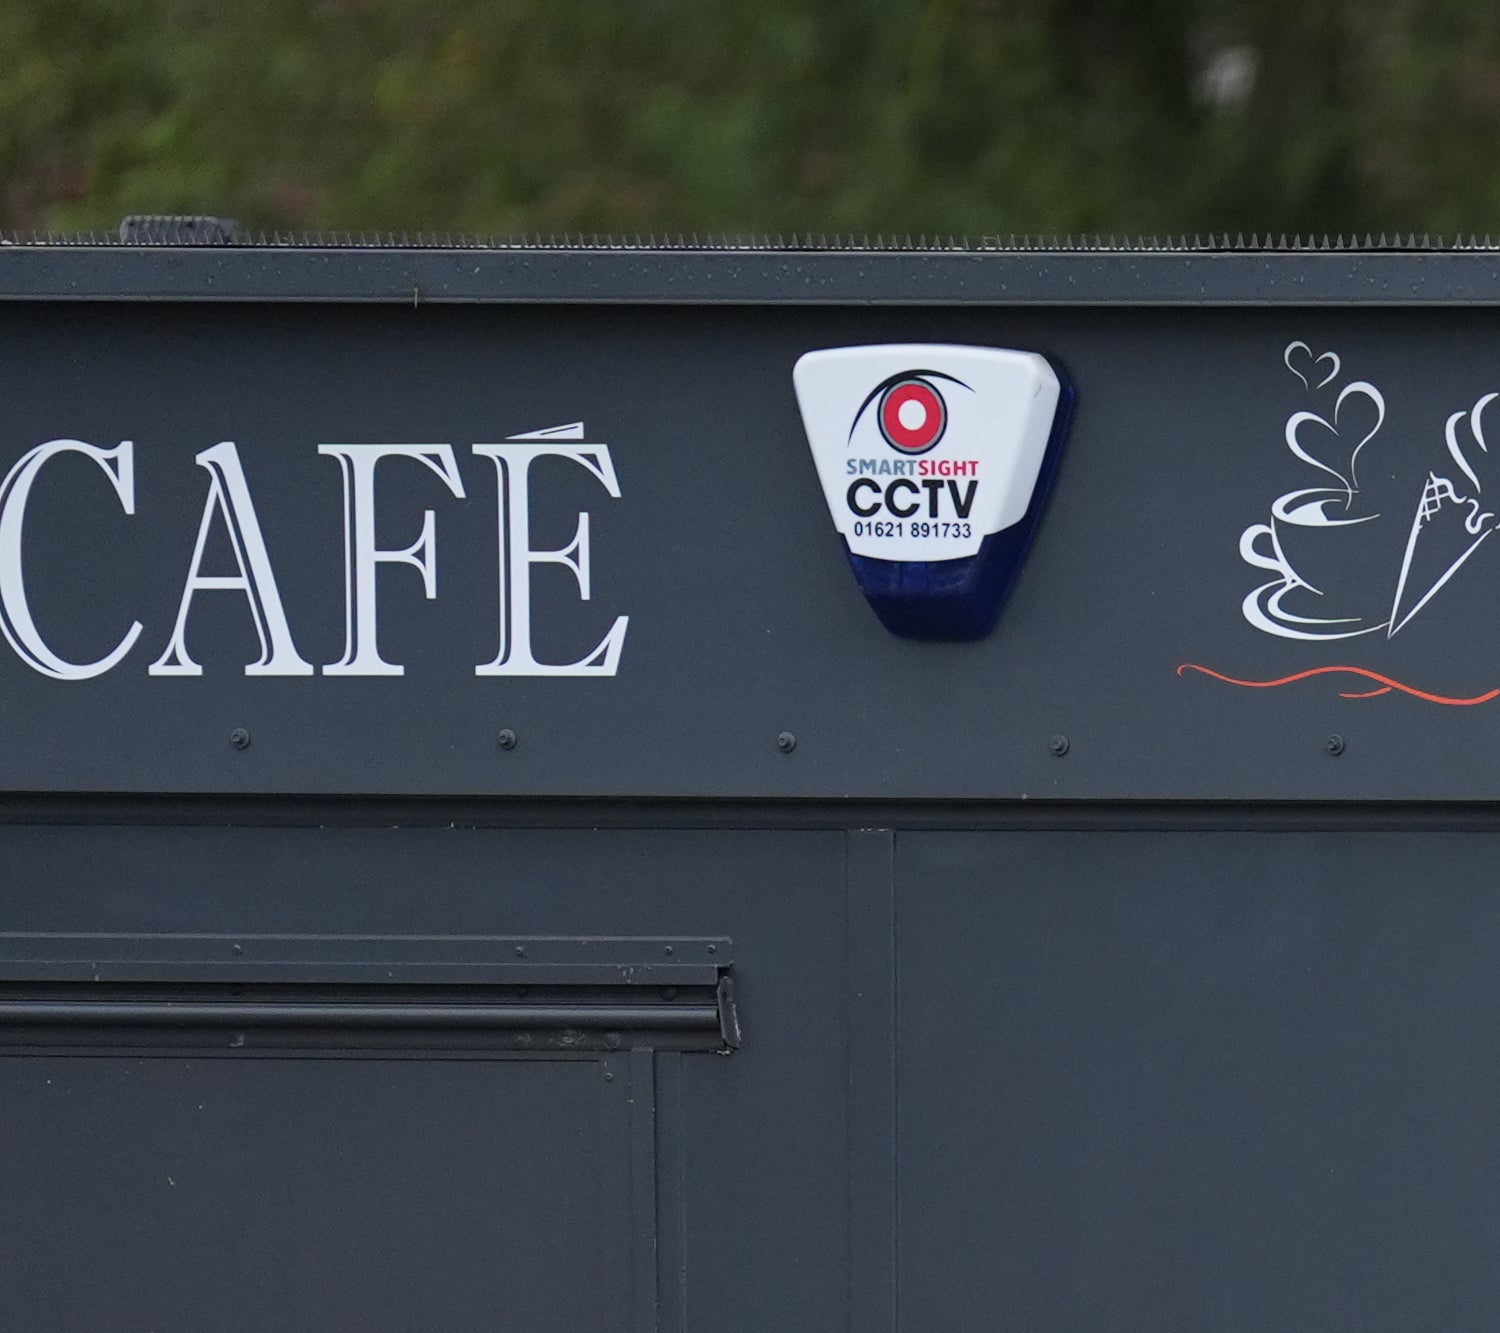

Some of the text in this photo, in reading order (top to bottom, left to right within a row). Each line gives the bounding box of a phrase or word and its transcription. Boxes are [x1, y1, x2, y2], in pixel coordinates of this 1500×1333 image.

[846, 458, 980, 476] SMARTSIGHT
[846, 477, 979, 519] CCTV
[854, 521, 972, 539] 01621 891733
[0, 421, 630, 680] CAFÉ
